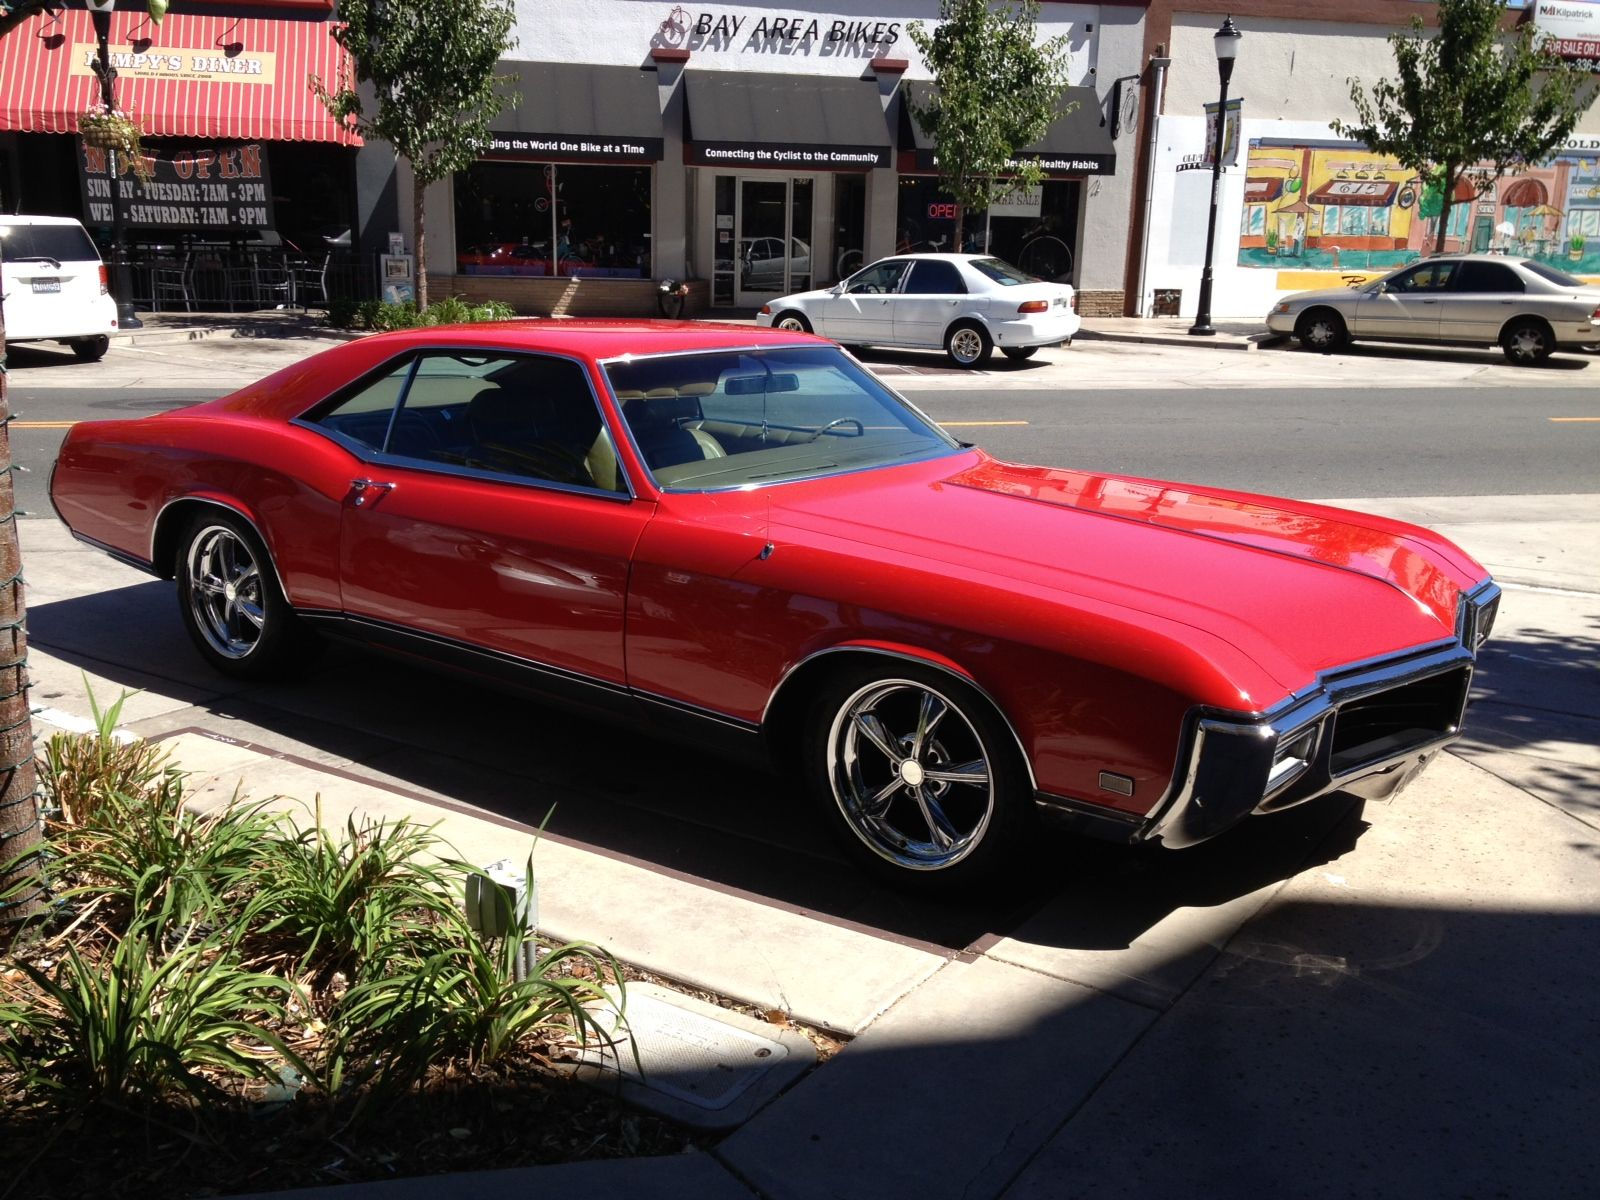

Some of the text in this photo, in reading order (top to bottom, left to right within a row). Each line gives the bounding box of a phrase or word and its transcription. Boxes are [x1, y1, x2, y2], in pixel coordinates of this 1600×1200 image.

[696, 13, 901, 44] BAY AREA BIKES
[1562, 41, 1583, 55] SALE
[1584, 42, 1596, 56] OR
[191, 56, 262, 74] DINER
[512, 140, 528, 149] the
[529, 140, 558, 150] World
[560, 142, 579, 151] One
[580, 143, 601, 152] Bike
[603, 144, 613, 153] at
[614, 145, 620, 153] a
[622, 144, 645, 154] Time
[705, 148, 879, 163] Connecting the Cyclist to the Community
[172, 145, 262, 179] OPEN
[1040, 160, 1071, 170] Healthy
[1072, 160, 1099, 169] Habits
[87, 179, 134, 199] SUNAY
[143, 182, 200, 202] TUESDAY:
[201, 184, 229, 202] 7AM
[238, 184, 266, 202] 3PM
[130, 204, 200, 223] SATURDAY:
[201, 207, 229, 225] 7AM
[239, 207, 268, 225] 9PM
